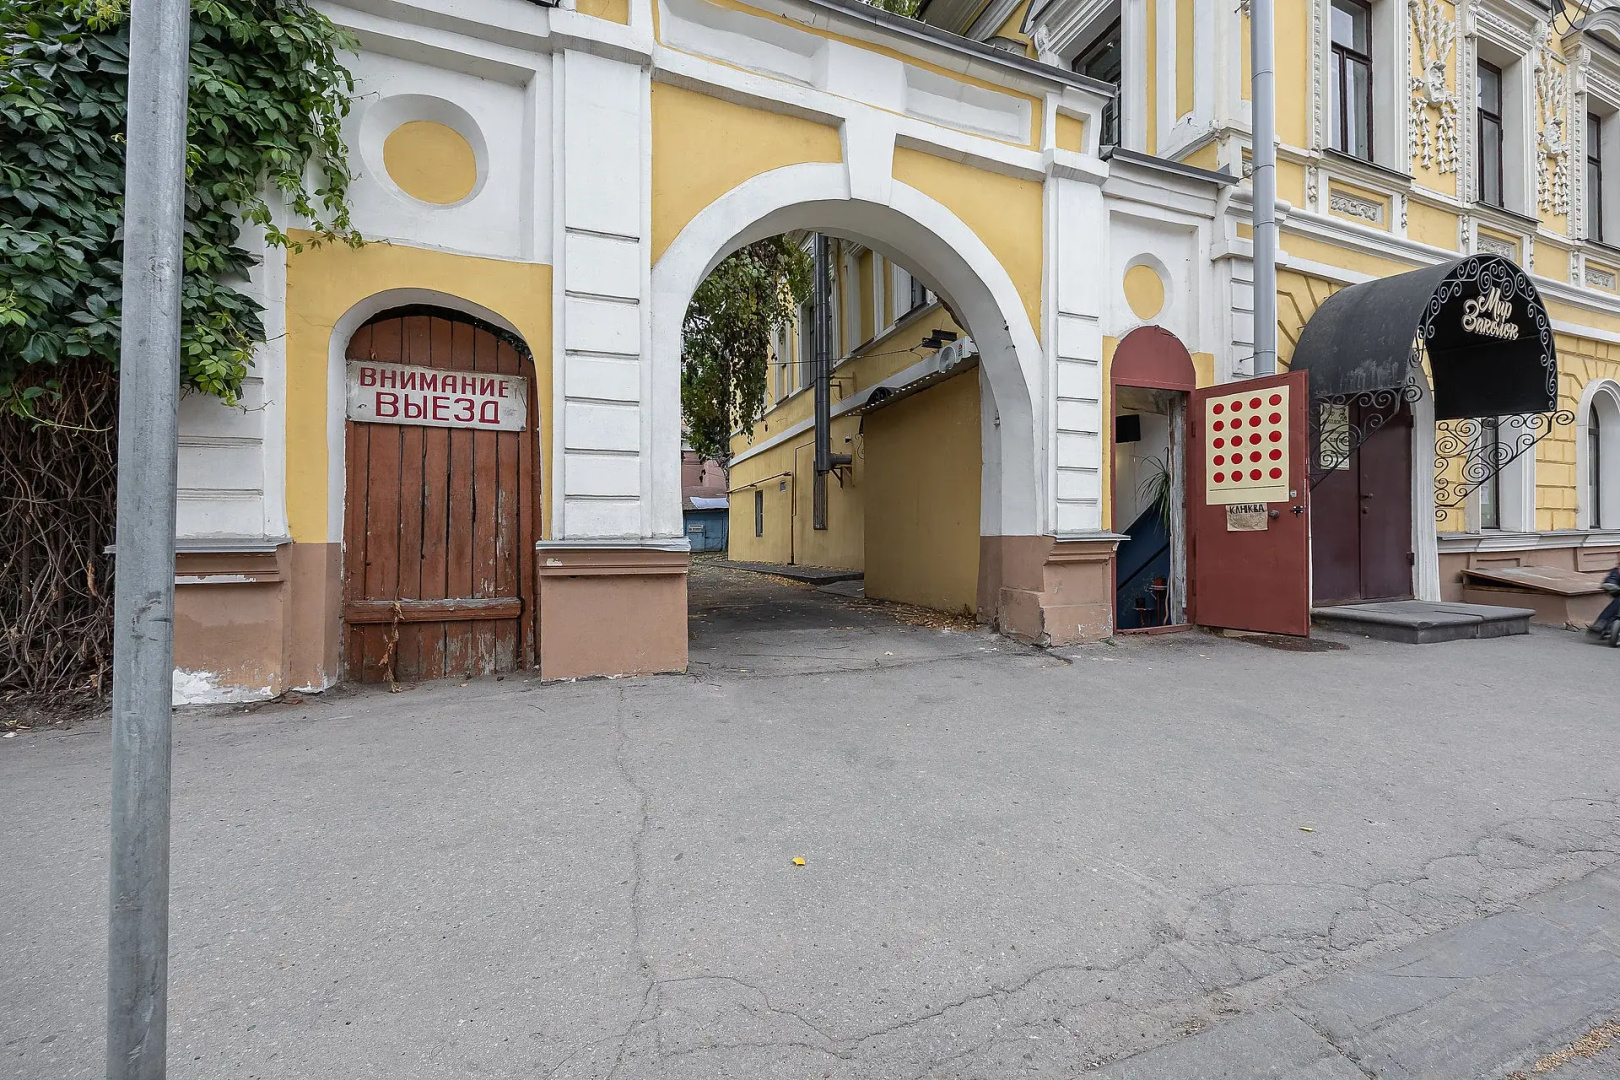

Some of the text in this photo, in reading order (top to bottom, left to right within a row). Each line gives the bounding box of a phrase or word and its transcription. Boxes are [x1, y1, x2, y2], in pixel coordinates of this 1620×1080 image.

[1463, 299, 1519, 340] Заколок
[1478, 286, 1512, 323] Мир
[360, 366, 508, 398] ВНИМАНИЕ
[375, 391, 500, 424] ВЫЕЗД
